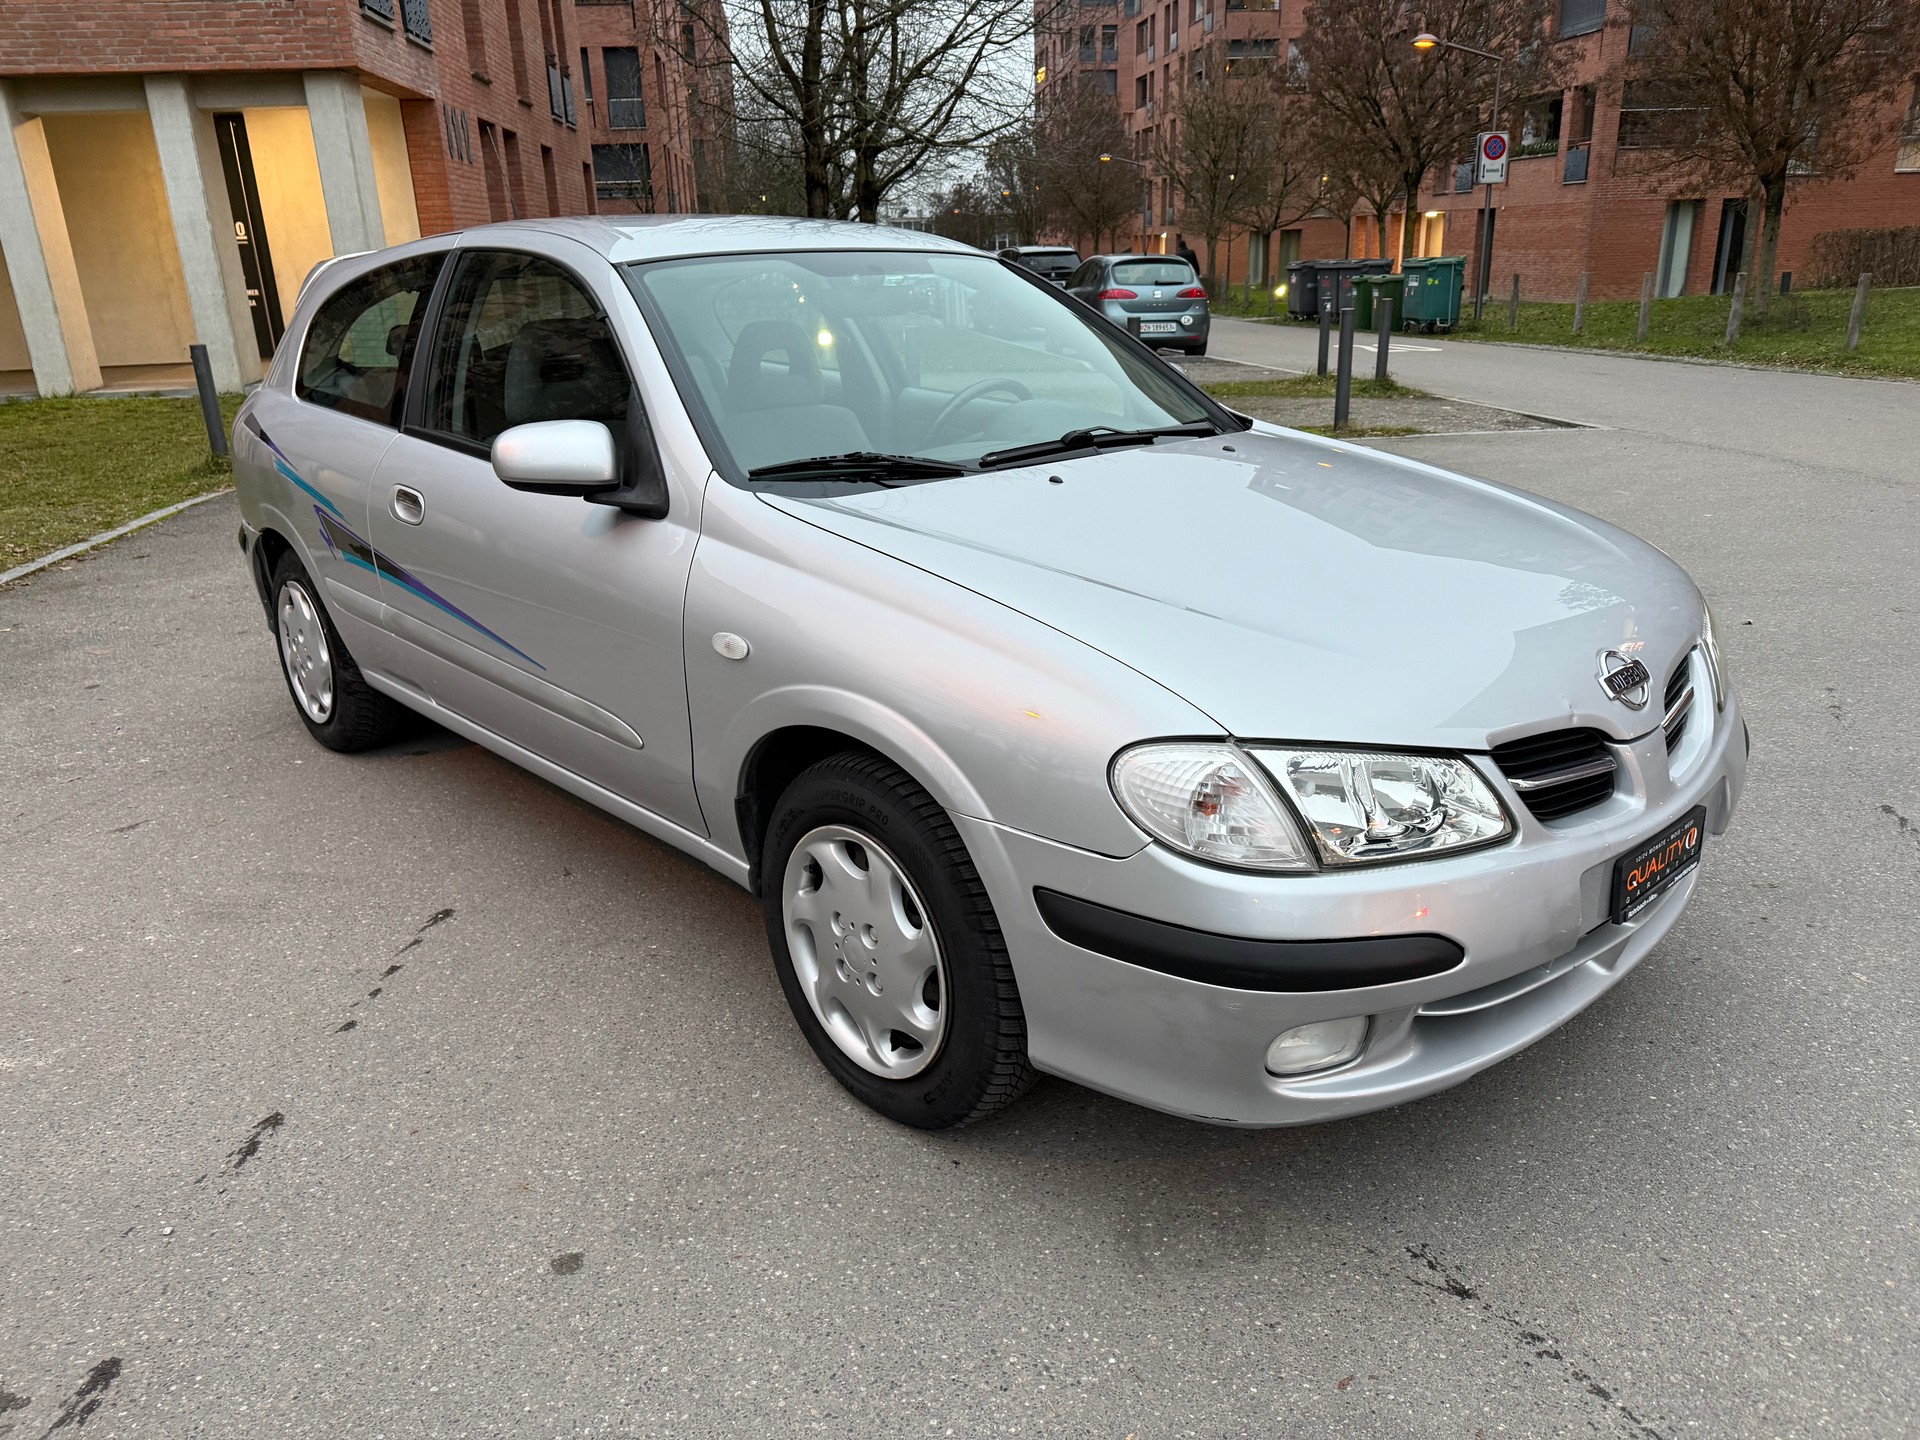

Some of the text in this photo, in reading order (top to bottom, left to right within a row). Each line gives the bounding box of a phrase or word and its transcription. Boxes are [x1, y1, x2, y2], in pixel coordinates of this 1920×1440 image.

[1612, 665, 1647, 691] NISSAN
[815, 788, 889, 826] SUPERGRIP PRO
